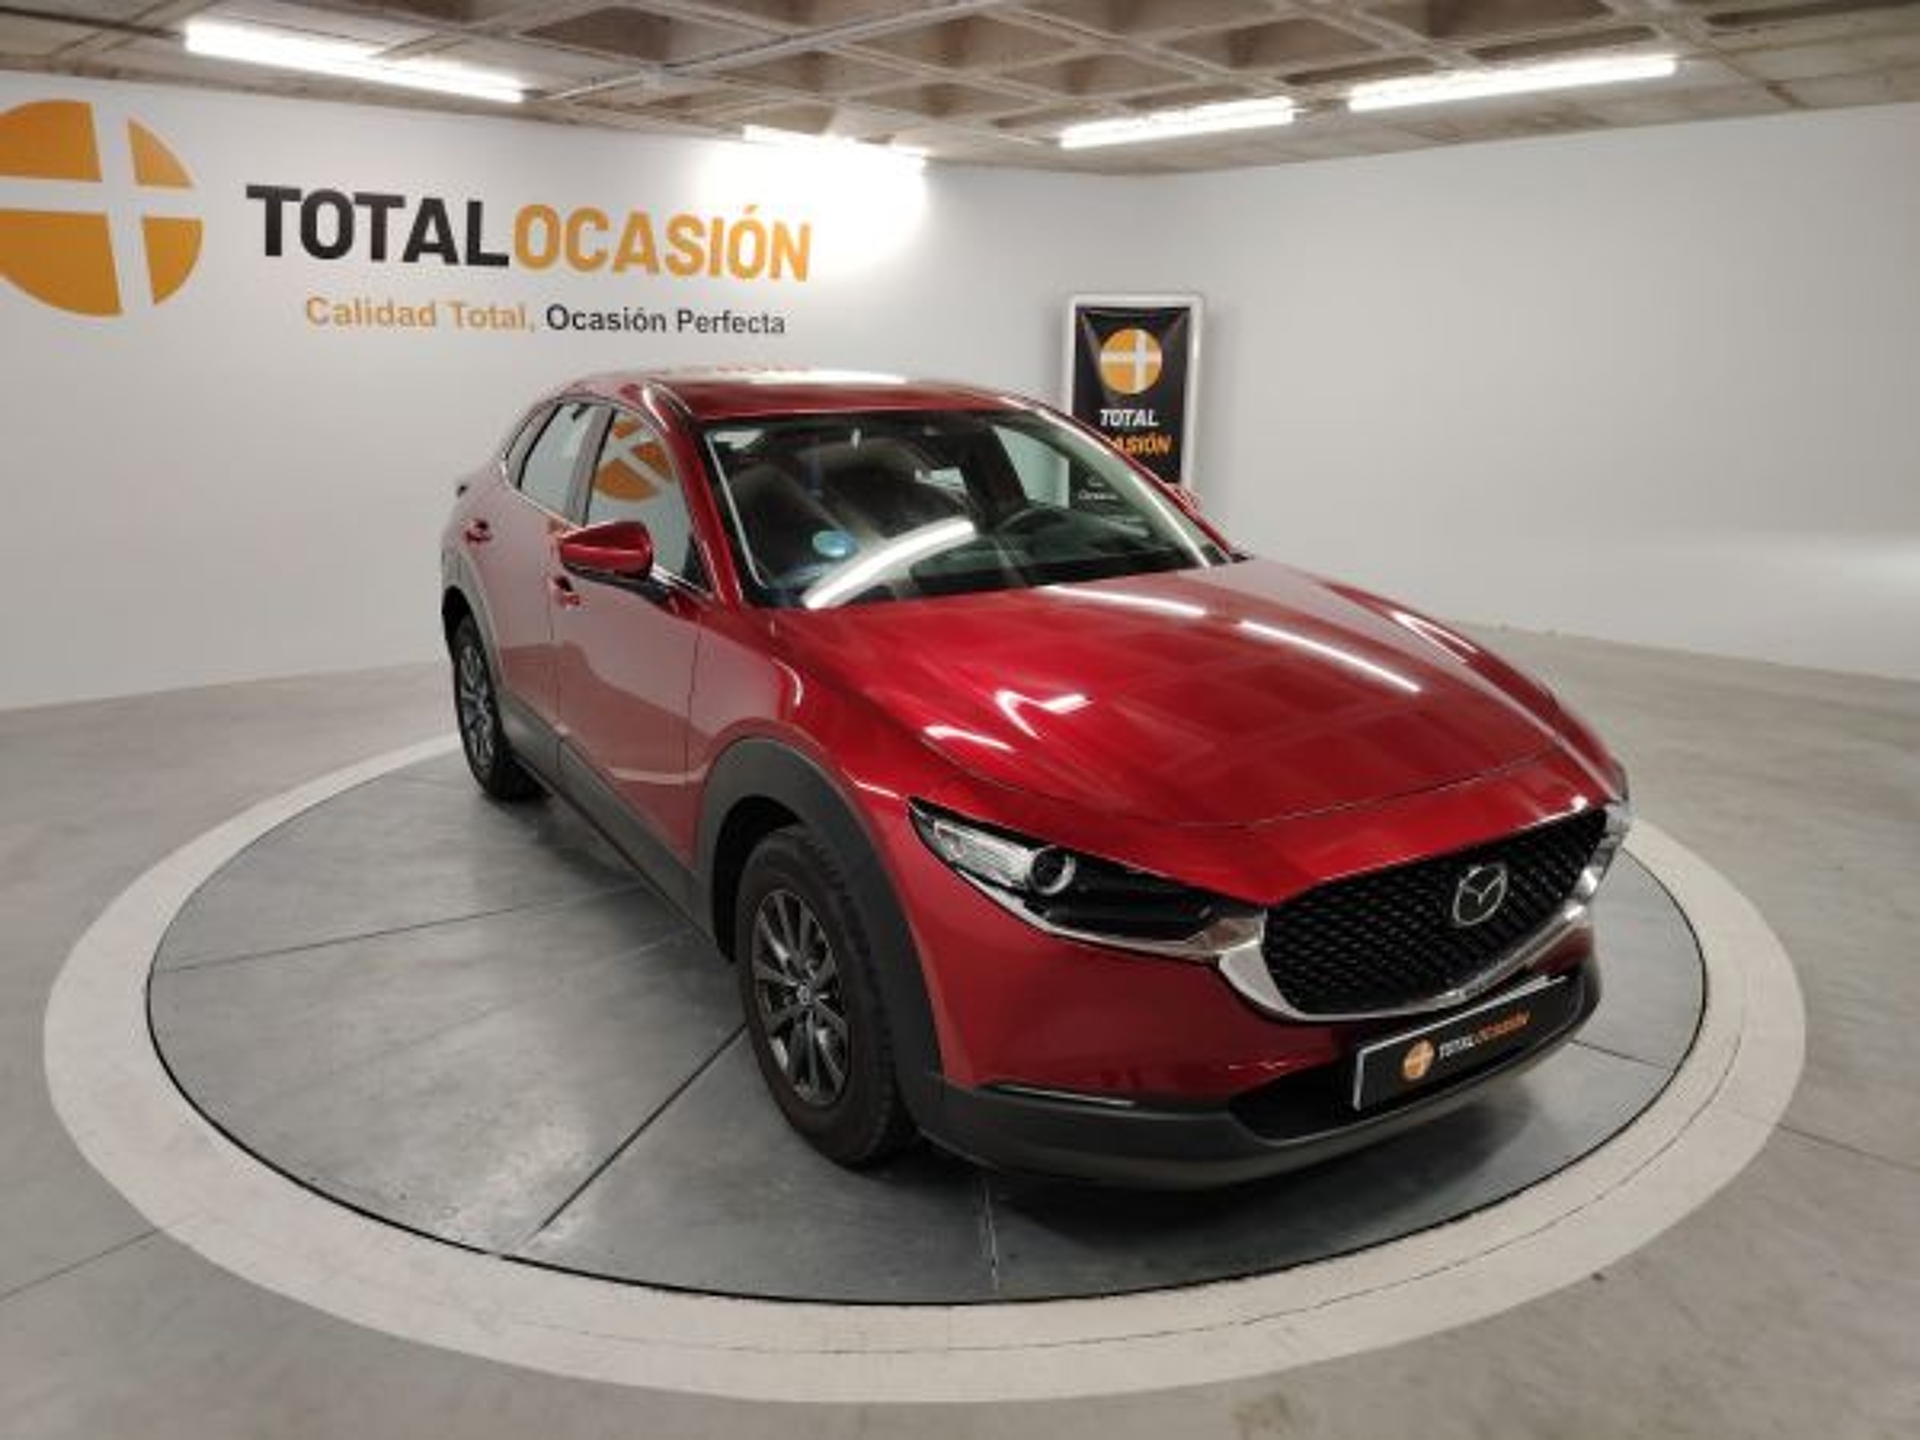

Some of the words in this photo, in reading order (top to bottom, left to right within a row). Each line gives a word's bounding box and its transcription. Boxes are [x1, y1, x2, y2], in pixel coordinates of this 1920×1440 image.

[305, 297, 437, 328] Calidad
[546, 304, 667, 333] Ocasión
[677, 309, 786, 334] Perfecta
[1100, 409, 1159, 427] TOTAL
